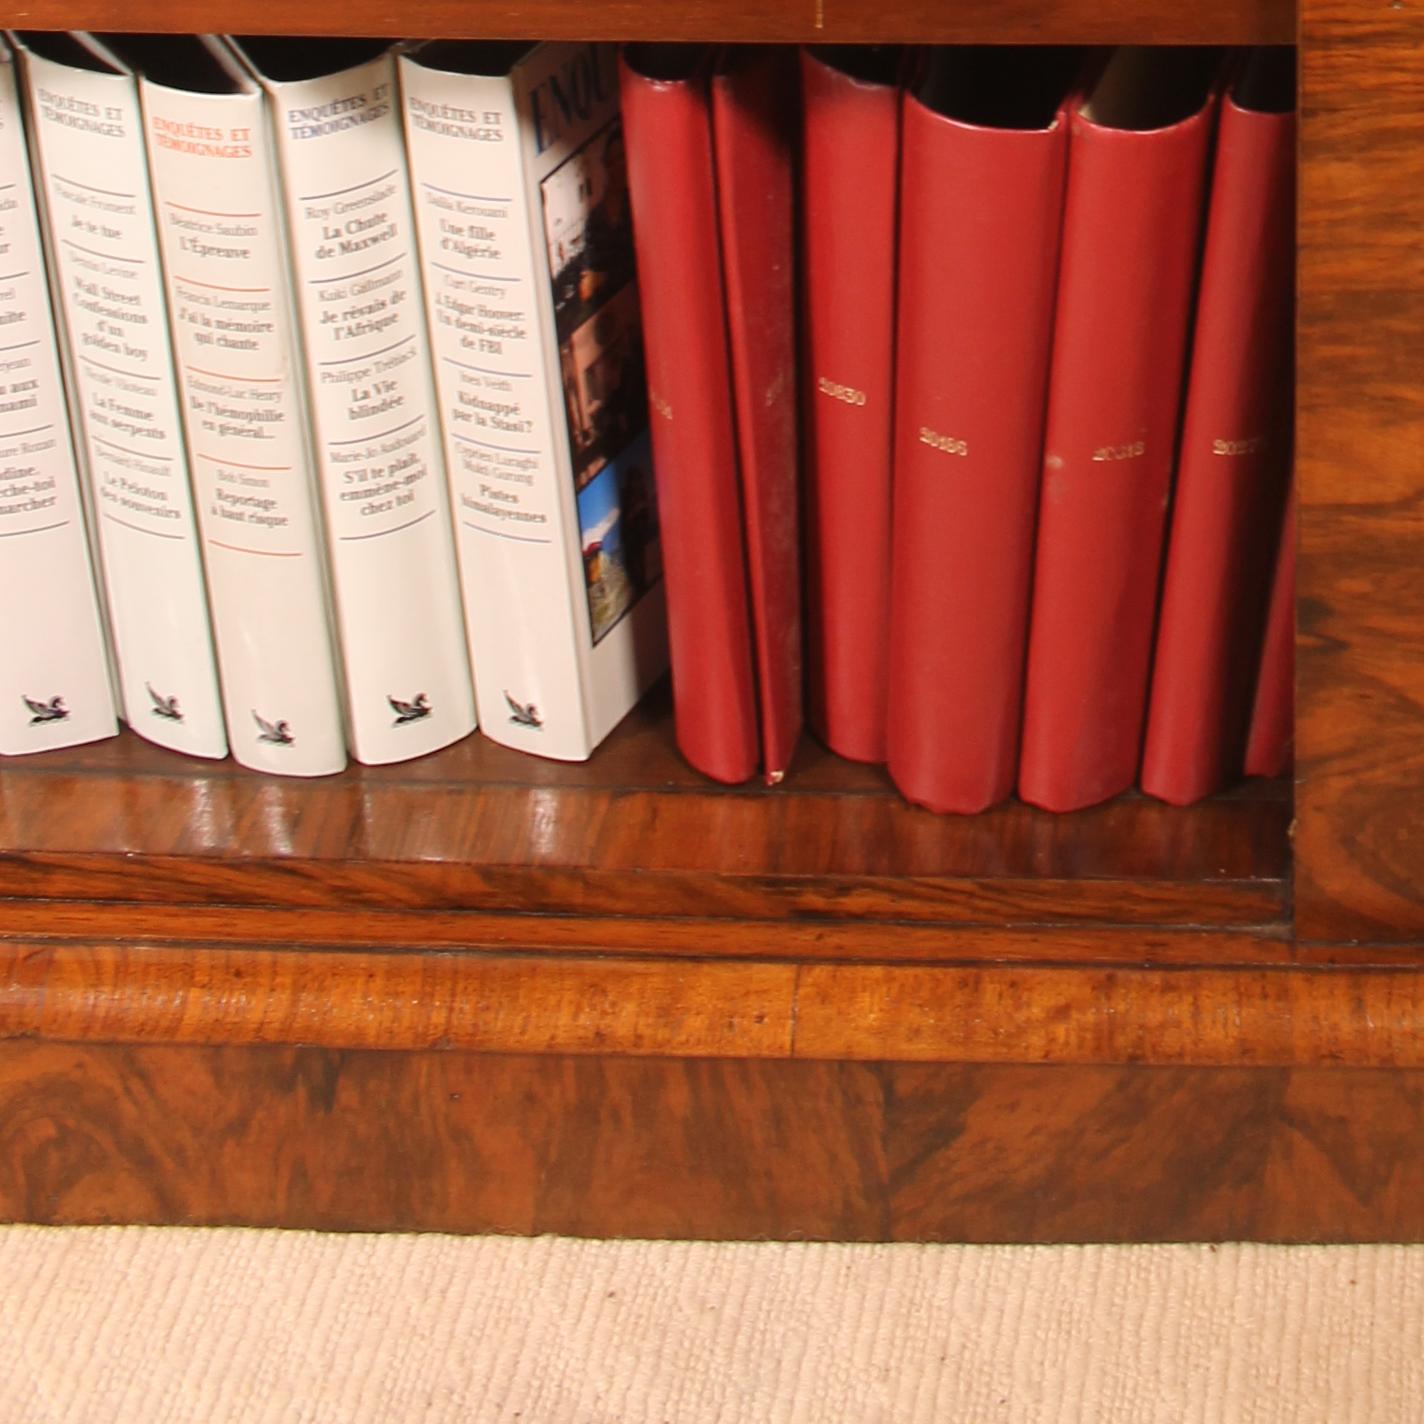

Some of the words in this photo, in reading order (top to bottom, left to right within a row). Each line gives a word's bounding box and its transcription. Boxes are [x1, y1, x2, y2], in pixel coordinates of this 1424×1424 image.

[38, 88, 99, 116] ENQUÊTES
[105, 107, 122, 120] ET
[288, 94, 367, 123] ENQUÊTES
[374, 83, 392, 100] ET
[409, 96, 477, 123] ENQUÊTES
[482, 111, 503, 125] ET
[40, 105, 126, 138] TÉMOIGNAGES
[152, 116, 224, 141] ENQUÊTES
[230, 128, 251, 142] ET
[289, 104, 391, 140] TÉMOIGNAGES
[411, 113, 503, 142] TÉMOIGNAGES
[154, 132, 253, 158] TÉMOIGNAGES
[322, 225, 342, 240] La
[345, 212, 388, 235] Chute
[468, 225, 496, 242] fille
[315, 245, 336, 259] de
[339, 223, 398, 255] Maxwell
[320, 310, 338, 324] Je
[342, 299, 388, 321] rêvais
[390, 290, 407, 305] de
[200, 312, 213, 328] la
[214, 318, 274, 333] mémoire
[334, 312, 399, 340] l'Afrique
[121, 342, 148, 363] boy
[194, 332, 214, 346] qui
[215, 335, 260, 351] chante
[320, 367, 372, 385] Philippe
[92, 392, 107, 408] La
[352, 388, 371, 402] La
[372, 380, 398, 396] Vie
[457, 390, 521, 417] Kidnappé
[201, 419, 216, 431] en
[452, 408, 473, 421] par
[474, 412, 488, 427] la
[339, 463, 427, 501] emmène-moi
[343, 469, 368, 484] S'il
[371, 467, 385, 479] te
[216, 488, 278, 511] Reportage
[360, 499, 394, 516] chez
[395, 489, 415, 506] toi
[220, 506, 246, 522] haut
[248, 513, 289, 529] risque
